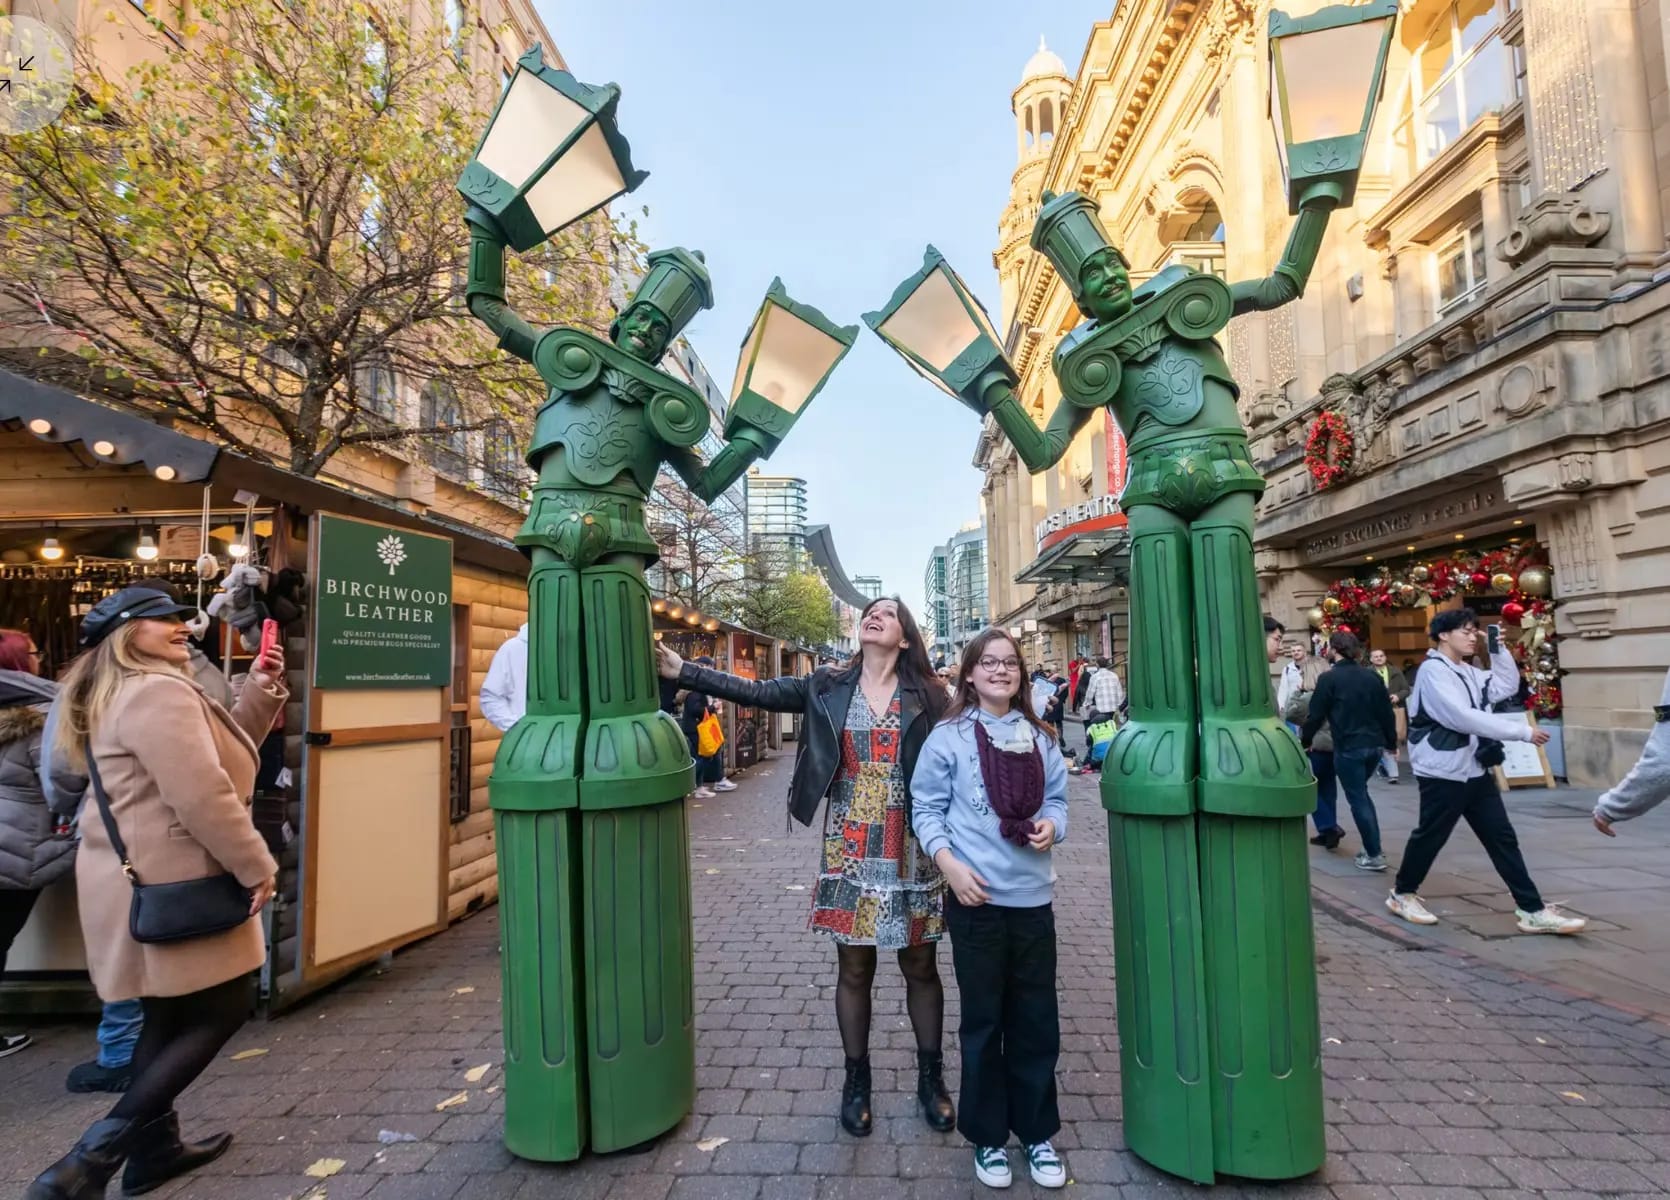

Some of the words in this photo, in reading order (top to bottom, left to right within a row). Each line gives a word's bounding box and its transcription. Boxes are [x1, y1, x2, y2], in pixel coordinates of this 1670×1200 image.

[1342, 513, 1413, 546] EXCHANGE
[326, 578, 448, 605] BIRCHWOOD
[345, 602, 434, 623] LEATHER
[342, 630, 376, 638] QUALITY
[377, 632, 408, 640] LEATHER
[350, 639, 385, 647] PREMIUM
[404, 641, 441, 649] SPECIALIST
[345, 673, 431, 681] www.birchwoodleather.co.uk
